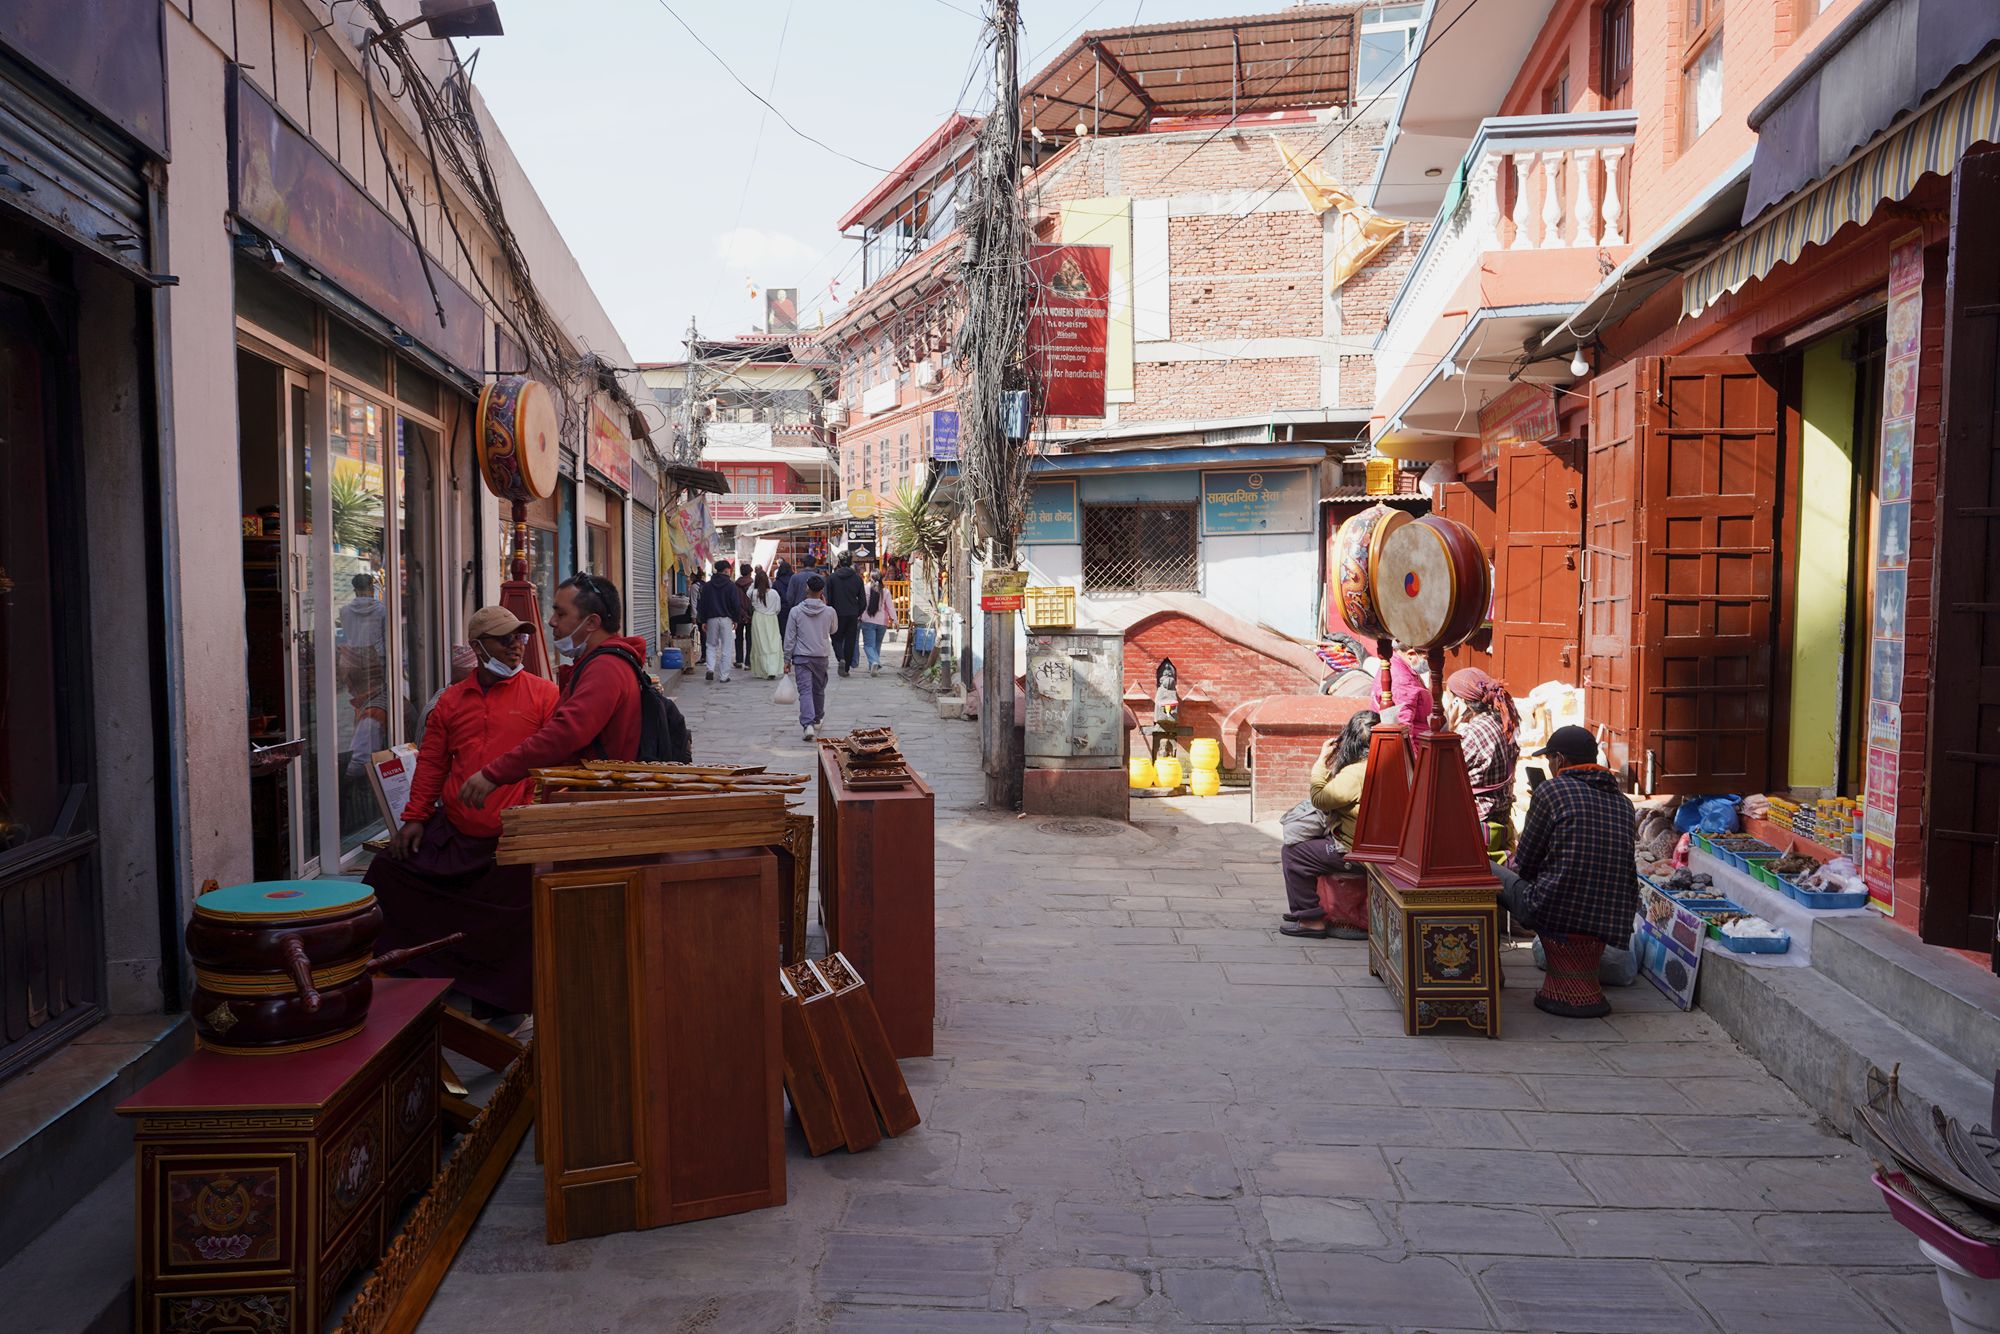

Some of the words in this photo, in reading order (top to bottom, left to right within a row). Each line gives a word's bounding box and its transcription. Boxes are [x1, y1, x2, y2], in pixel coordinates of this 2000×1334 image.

[1050, 307, 1074, 317] WOMENS
[1075, 308, 1106, 318] WORKSHOP
[1054, 368, 1064, 377] for
[1065, 369, 1103, 379] handicrafts!
[1207, 489, 1257, 505] सामुदायिक
[1261, 489, 1280, 501] सेवा
[1039, 510, 1053, 522] सेवा
